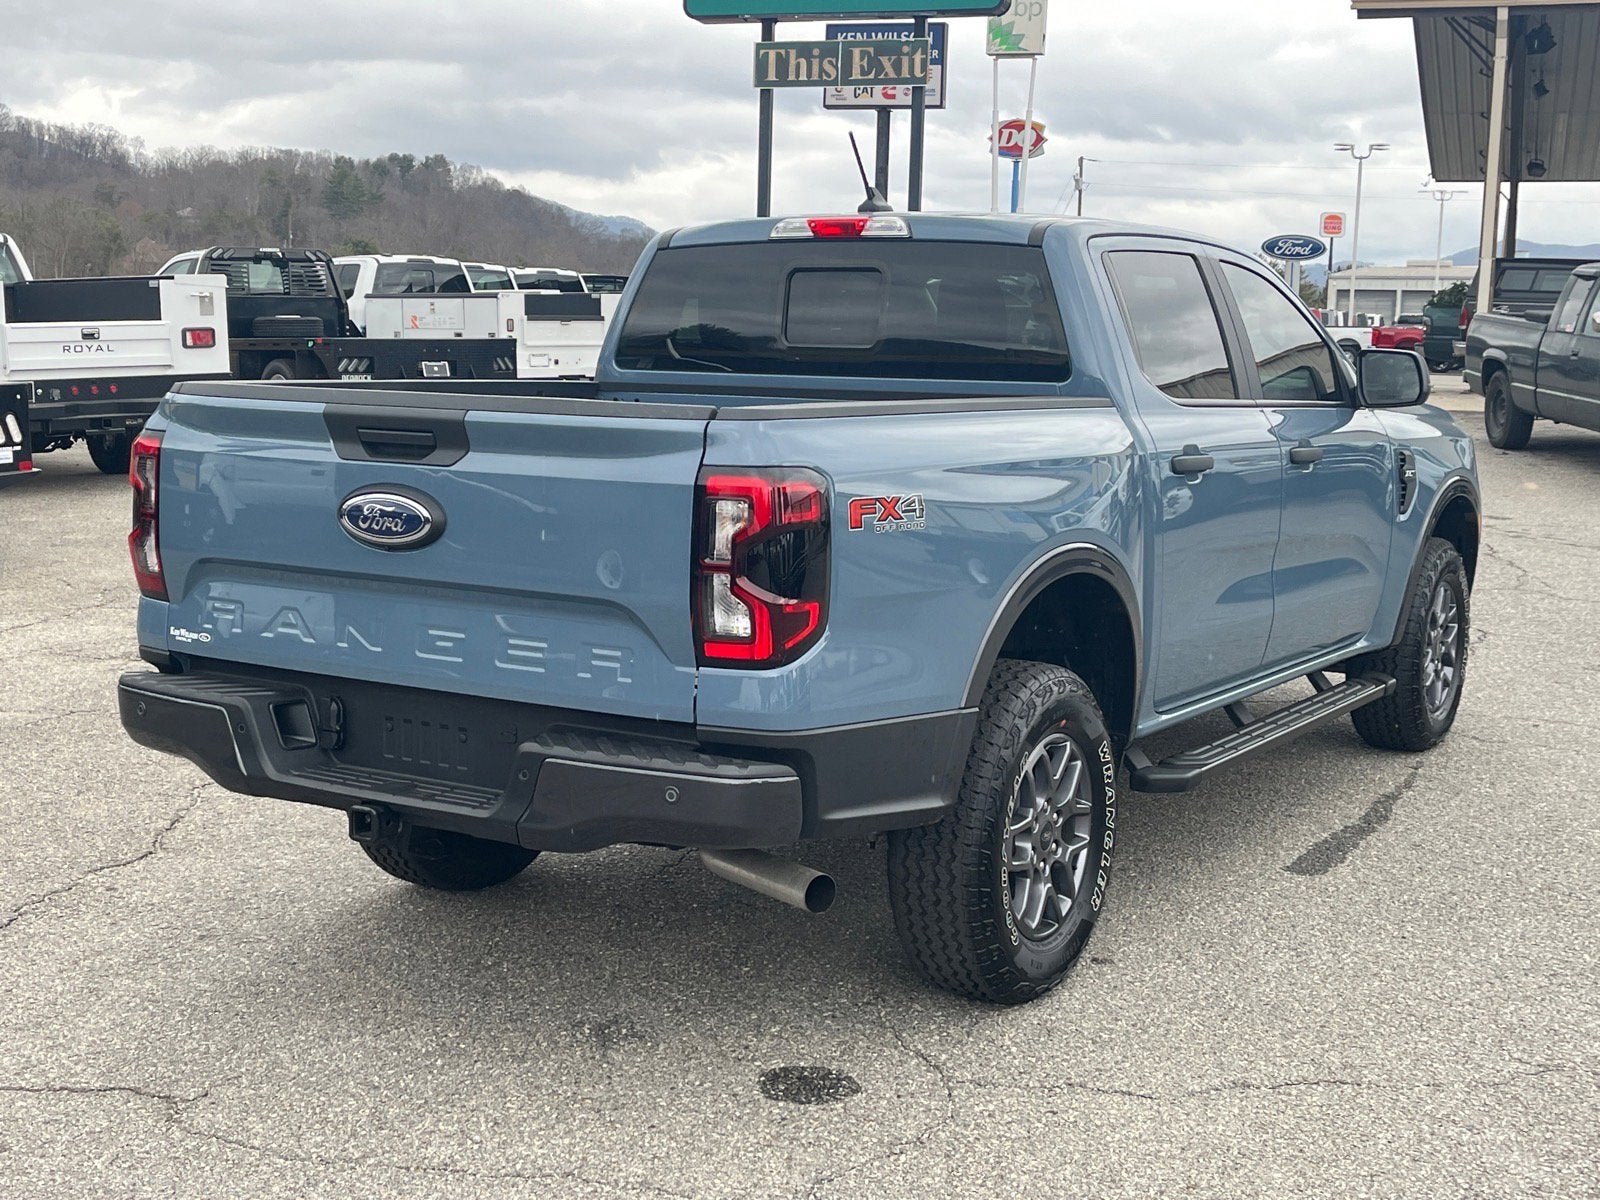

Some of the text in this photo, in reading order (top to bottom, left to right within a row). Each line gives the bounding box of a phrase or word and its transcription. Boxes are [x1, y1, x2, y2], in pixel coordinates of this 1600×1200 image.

[1013, 0, 1042, 21] bp
[759, 48, 837, 81] This
[848, 45, 927, 80] Exit
[853, 86, 875, 99] CAT
[1000, 128, 1036, 151] DQ
[1274, 239, 1312, 255] Ford
[62, 344, 115, 353] ROYAL
[358, 503, 407, 532] Ford
[848, 493, 926, 532] FX4
[874, 520, 927, 533] OFF ROAD
[202, 598, 637, 684] RANGER
[1089, 740, 1117, 912] WRANGLER
